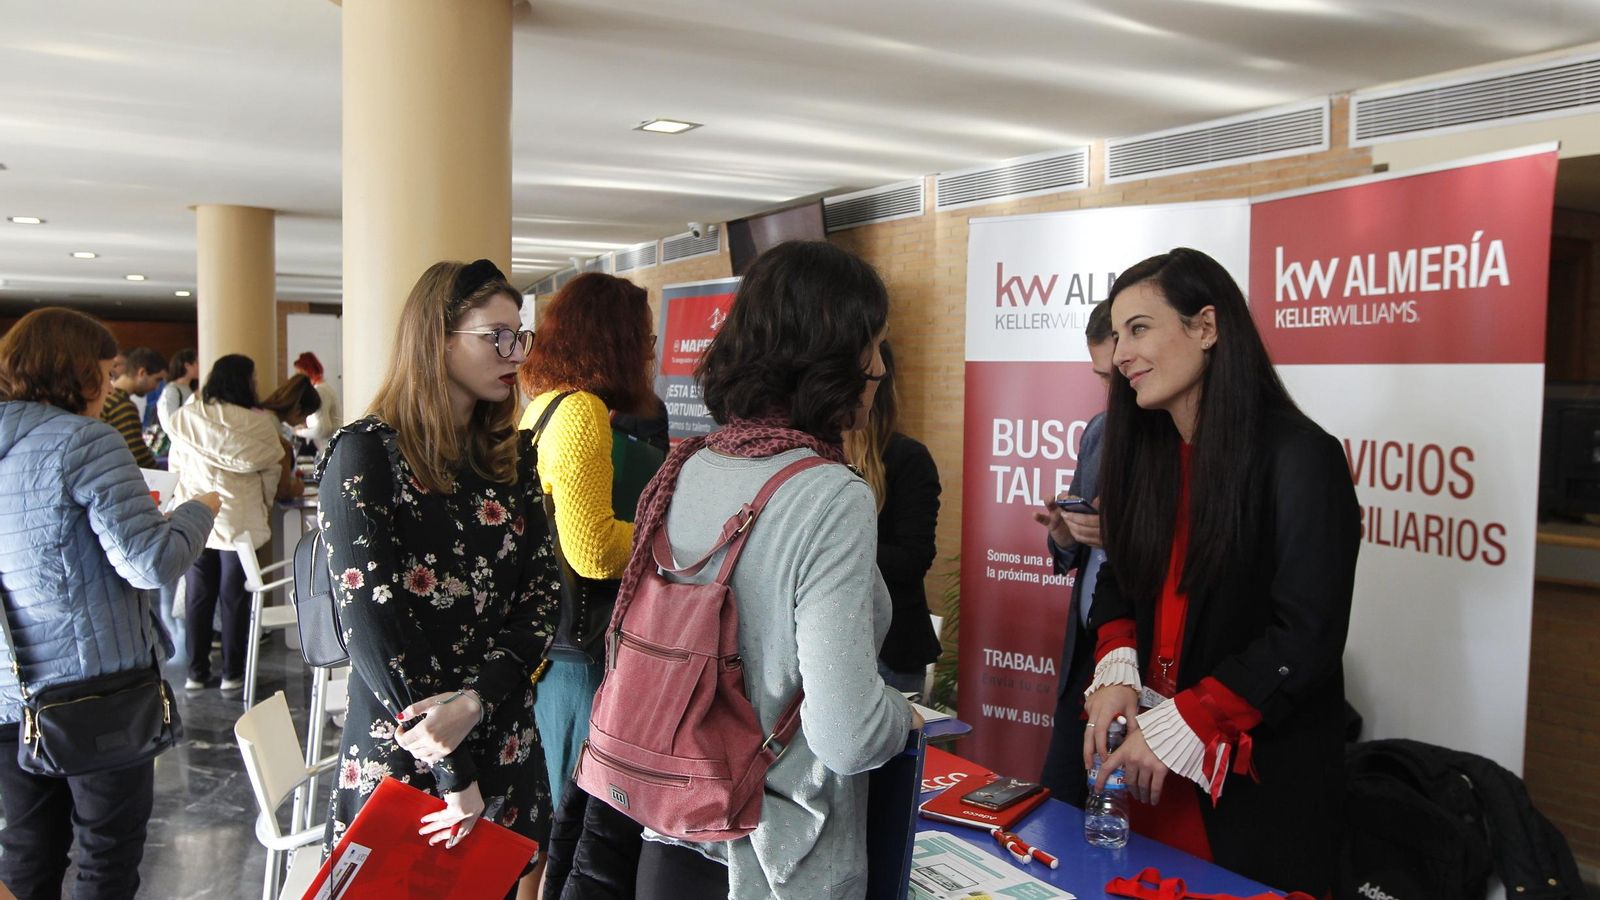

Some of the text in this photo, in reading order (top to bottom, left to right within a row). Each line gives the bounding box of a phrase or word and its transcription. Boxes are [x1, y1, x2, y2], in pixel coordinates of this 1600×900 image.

[1343, 230, 1510, 297] ALMERÍA
[995, 312, 1087, 330] KELLERWILL
[992, 418, 1088, 461] BUSC
[1344, 439, 1475, 500] VICIOS
[989, 465, 1075, 506] TALE
[987, 549, 1021, 564] Somos
[1023, 555, 1043, 567] una
[986, 566, 996, 578] la
[998, 568, 1040, 583] próxima
[983, 648, 1056, 676] TRABAJA
[982, 703, 1055, 728] WWW.BUS
[962, 810, 998, 821] Adecco
